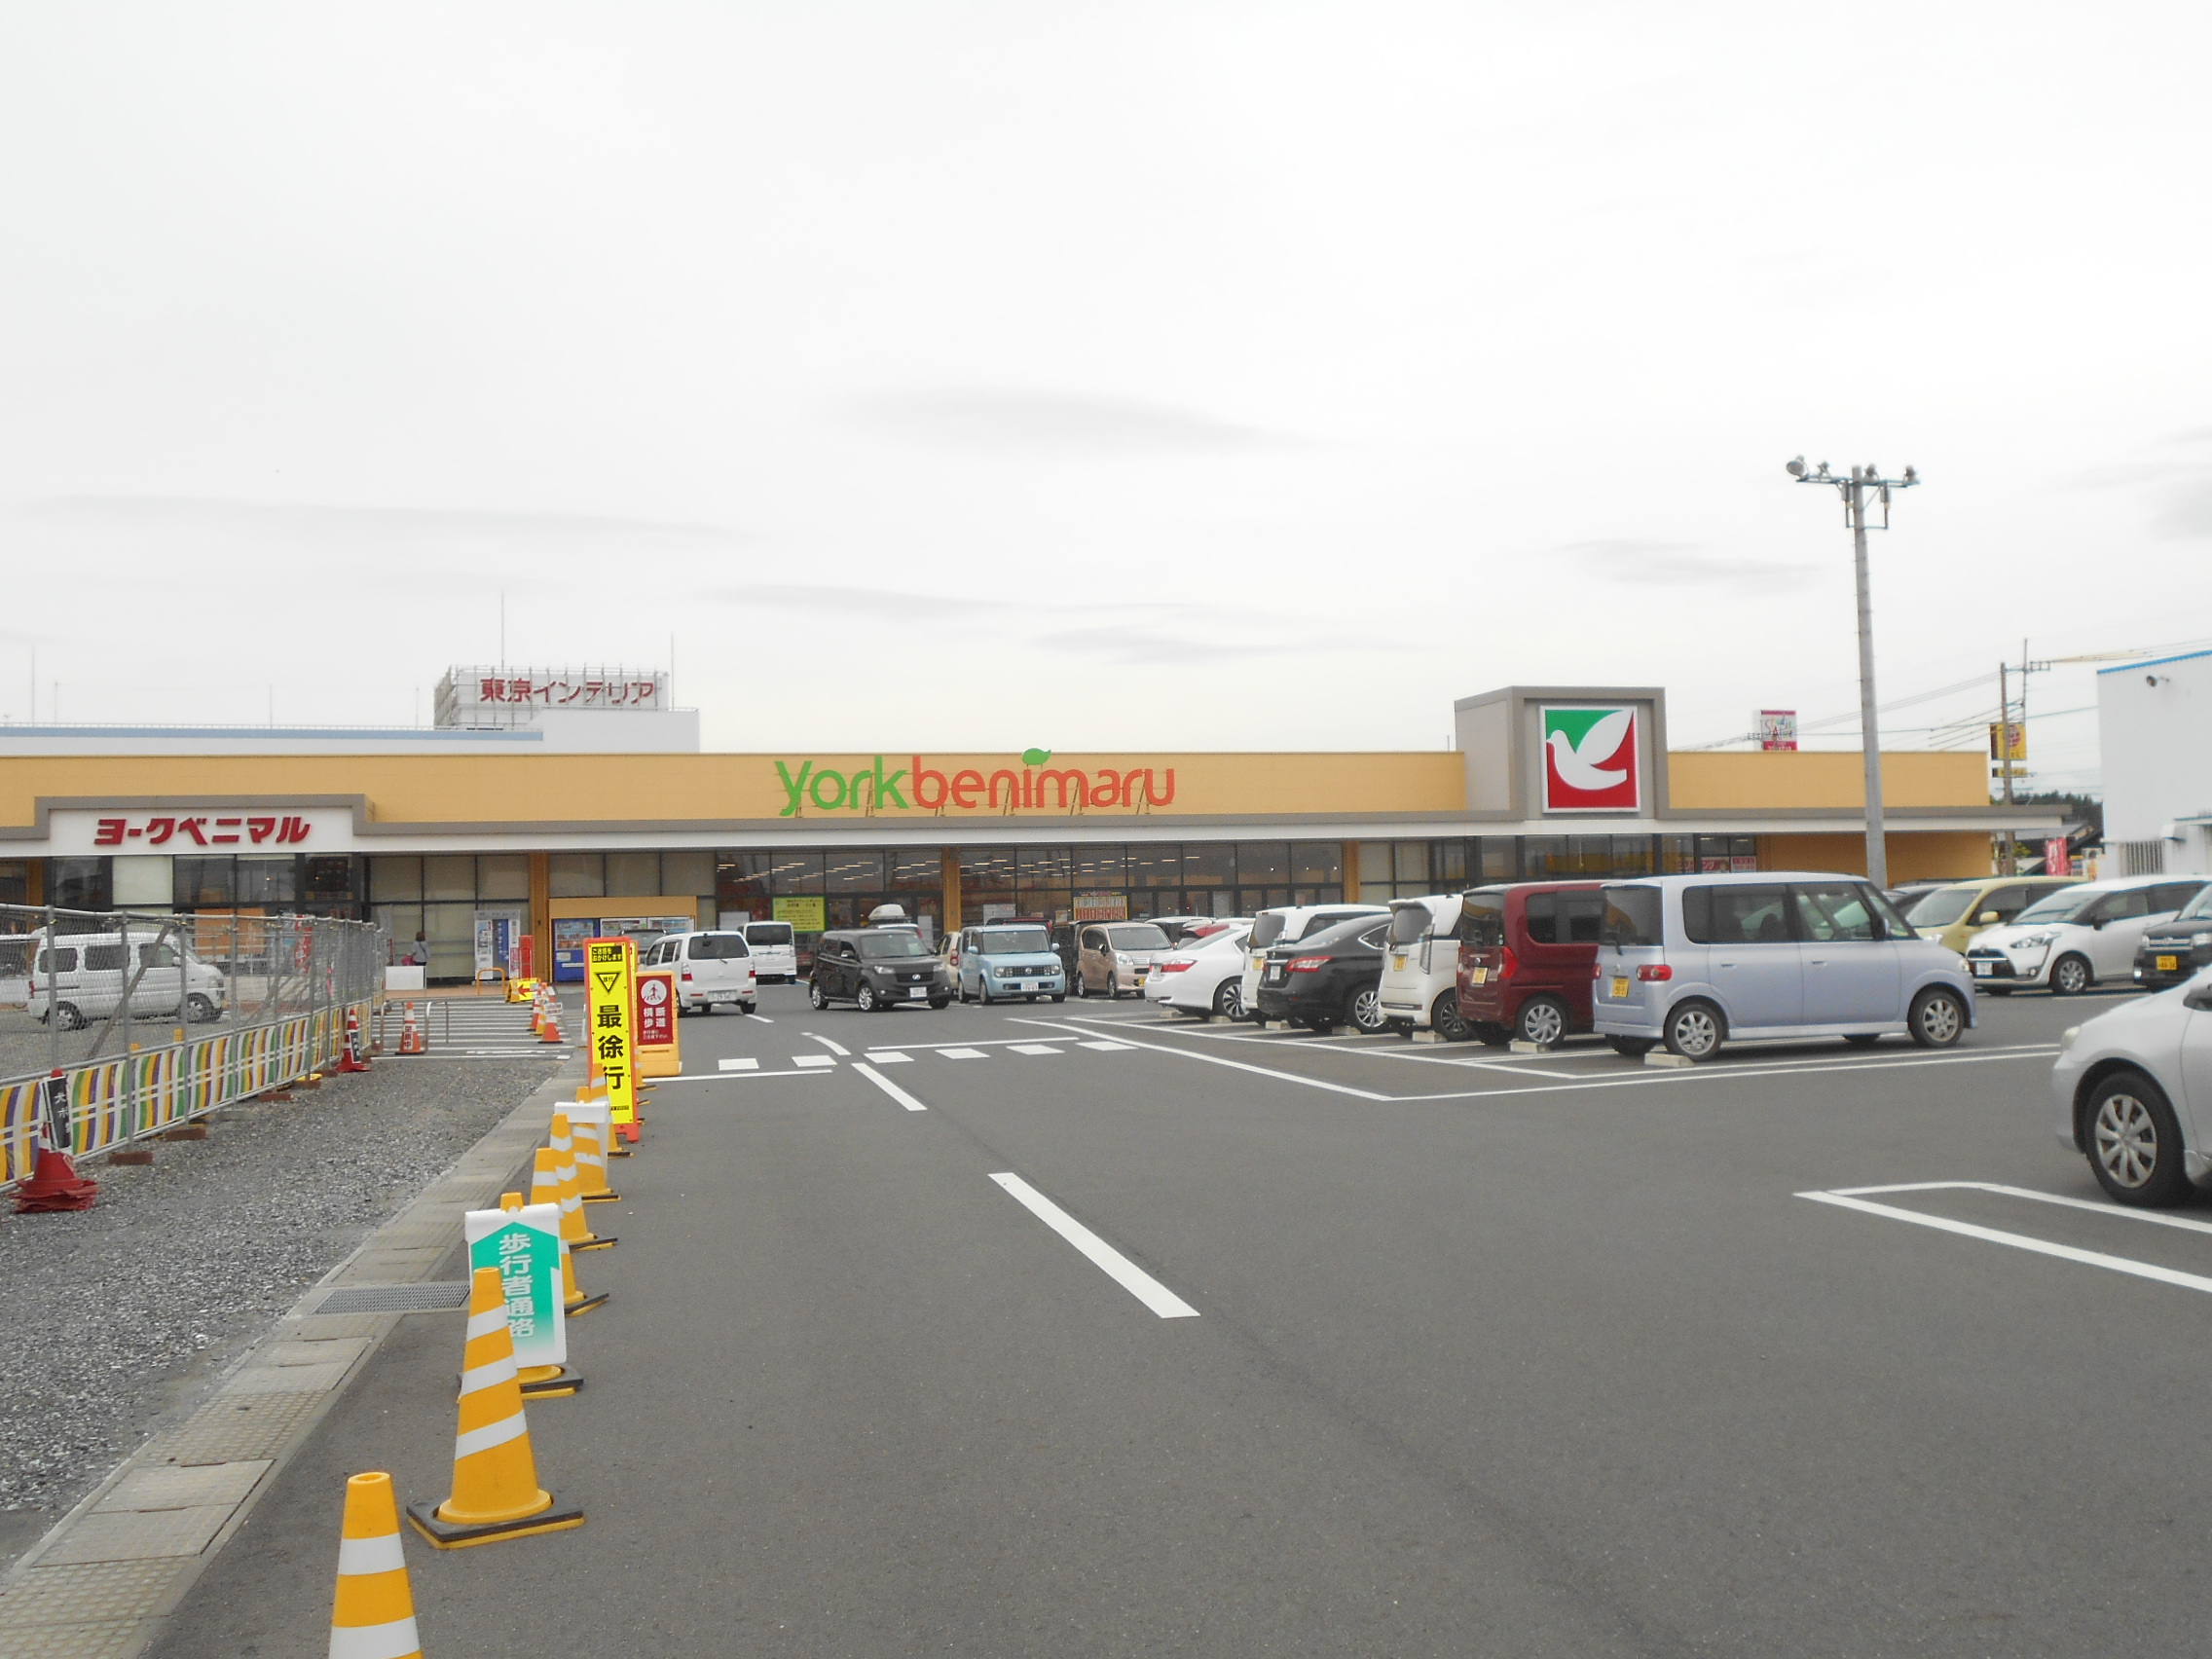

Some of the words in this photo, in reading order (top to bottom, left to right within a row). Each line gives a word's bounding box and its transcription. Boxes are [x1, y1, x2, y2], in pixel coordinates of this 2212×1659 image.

[480, 678, 654, 703] 東京インテリア
[774, 749, 1175, 816] yorkbenimaru
[93, 817, 311, 845] ヨークベニマル
[597, 1005, 625, 1089] 最徐行
[498, 1233, 535, 1338] 歩行者通路
